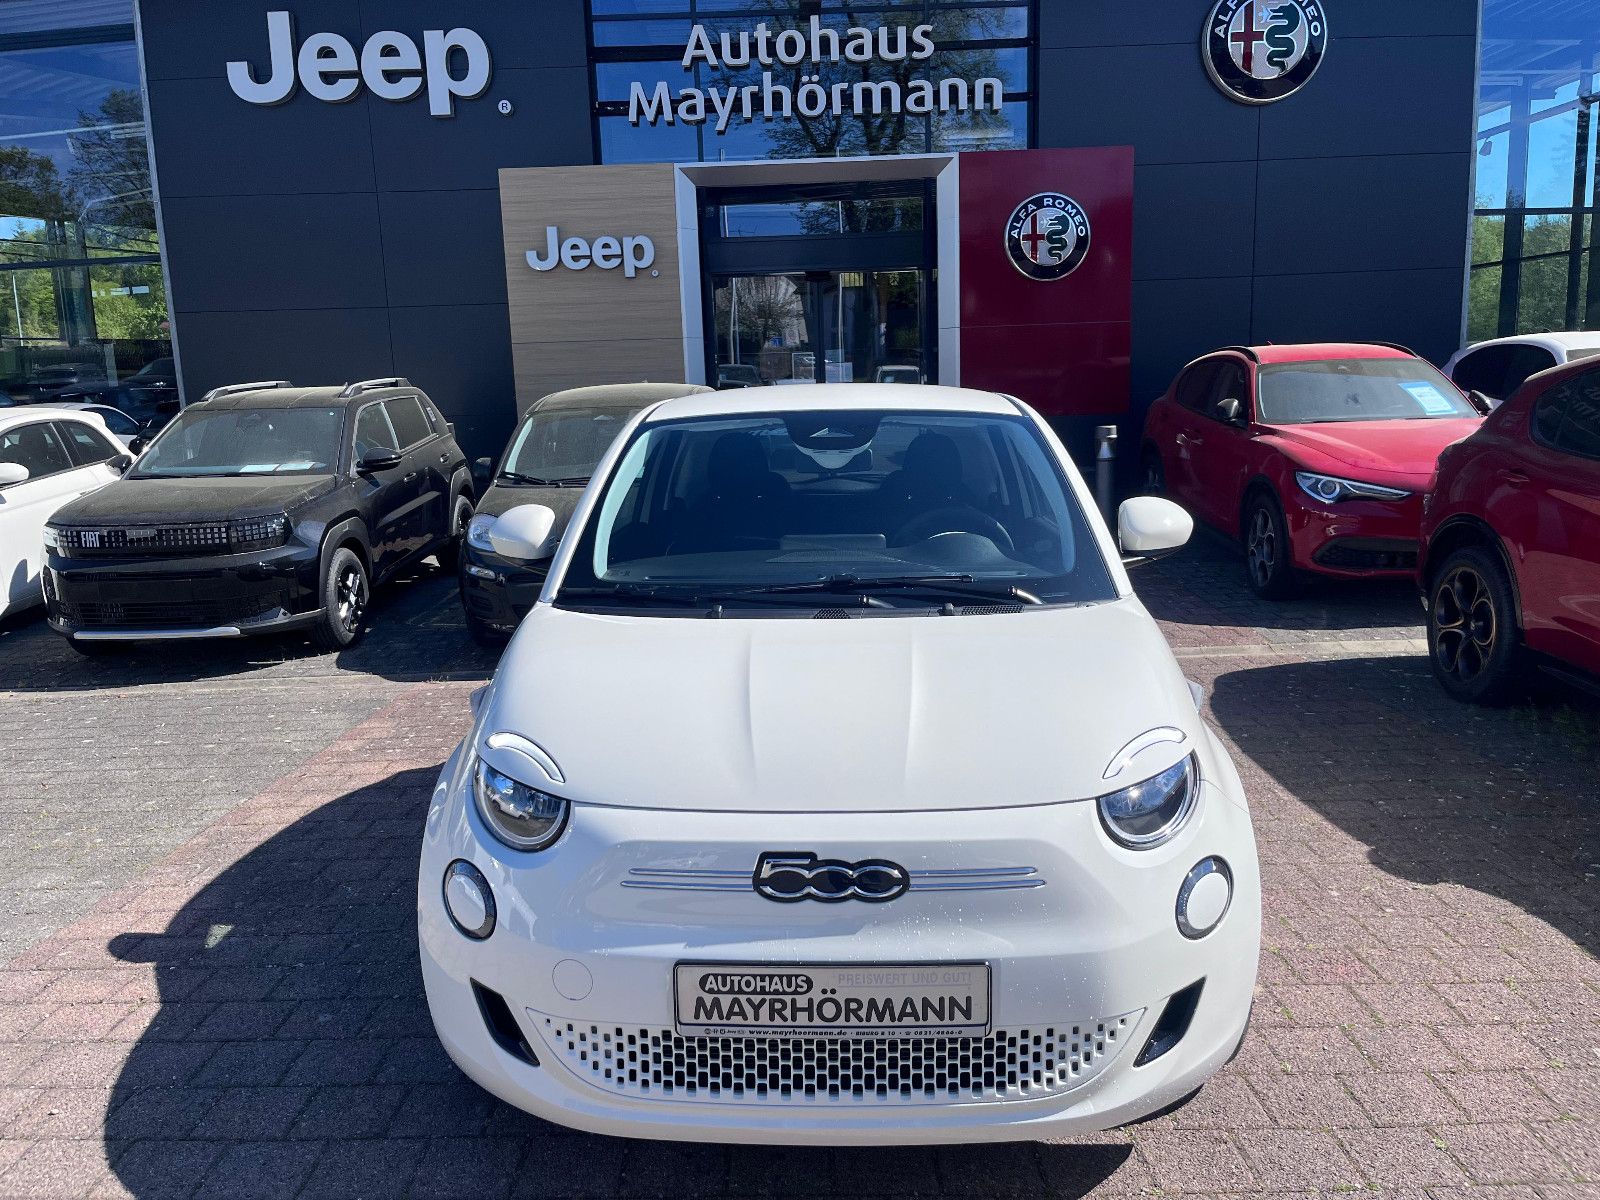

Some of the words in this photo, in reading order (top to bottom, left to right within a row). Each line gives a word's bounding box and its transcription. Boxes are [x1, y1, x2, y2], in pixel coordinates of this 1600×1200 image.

[226, 11, 491, 116] Jeep
[681, 14, 935, 68] Autohaus
[628, 72, 1003, 133] Mayrhörmann
[1010, 203, 1037, 239] ALFA
[1043, 197, 1086, 237] ROMEO
[525, 225, 655, 278] Jeep
[80, 531, 100, 548] FIAT
[754, 853, 909, 902] 500
[704, 974, 808, 993] AUTOHAUS
[838, 972, 908, 986] PREISWERT
[912, 972, 938, 985] UND
[943, 971, 972, 984] GUT!
[693, 987, 973, 1023] MAYRHÖRMANN
